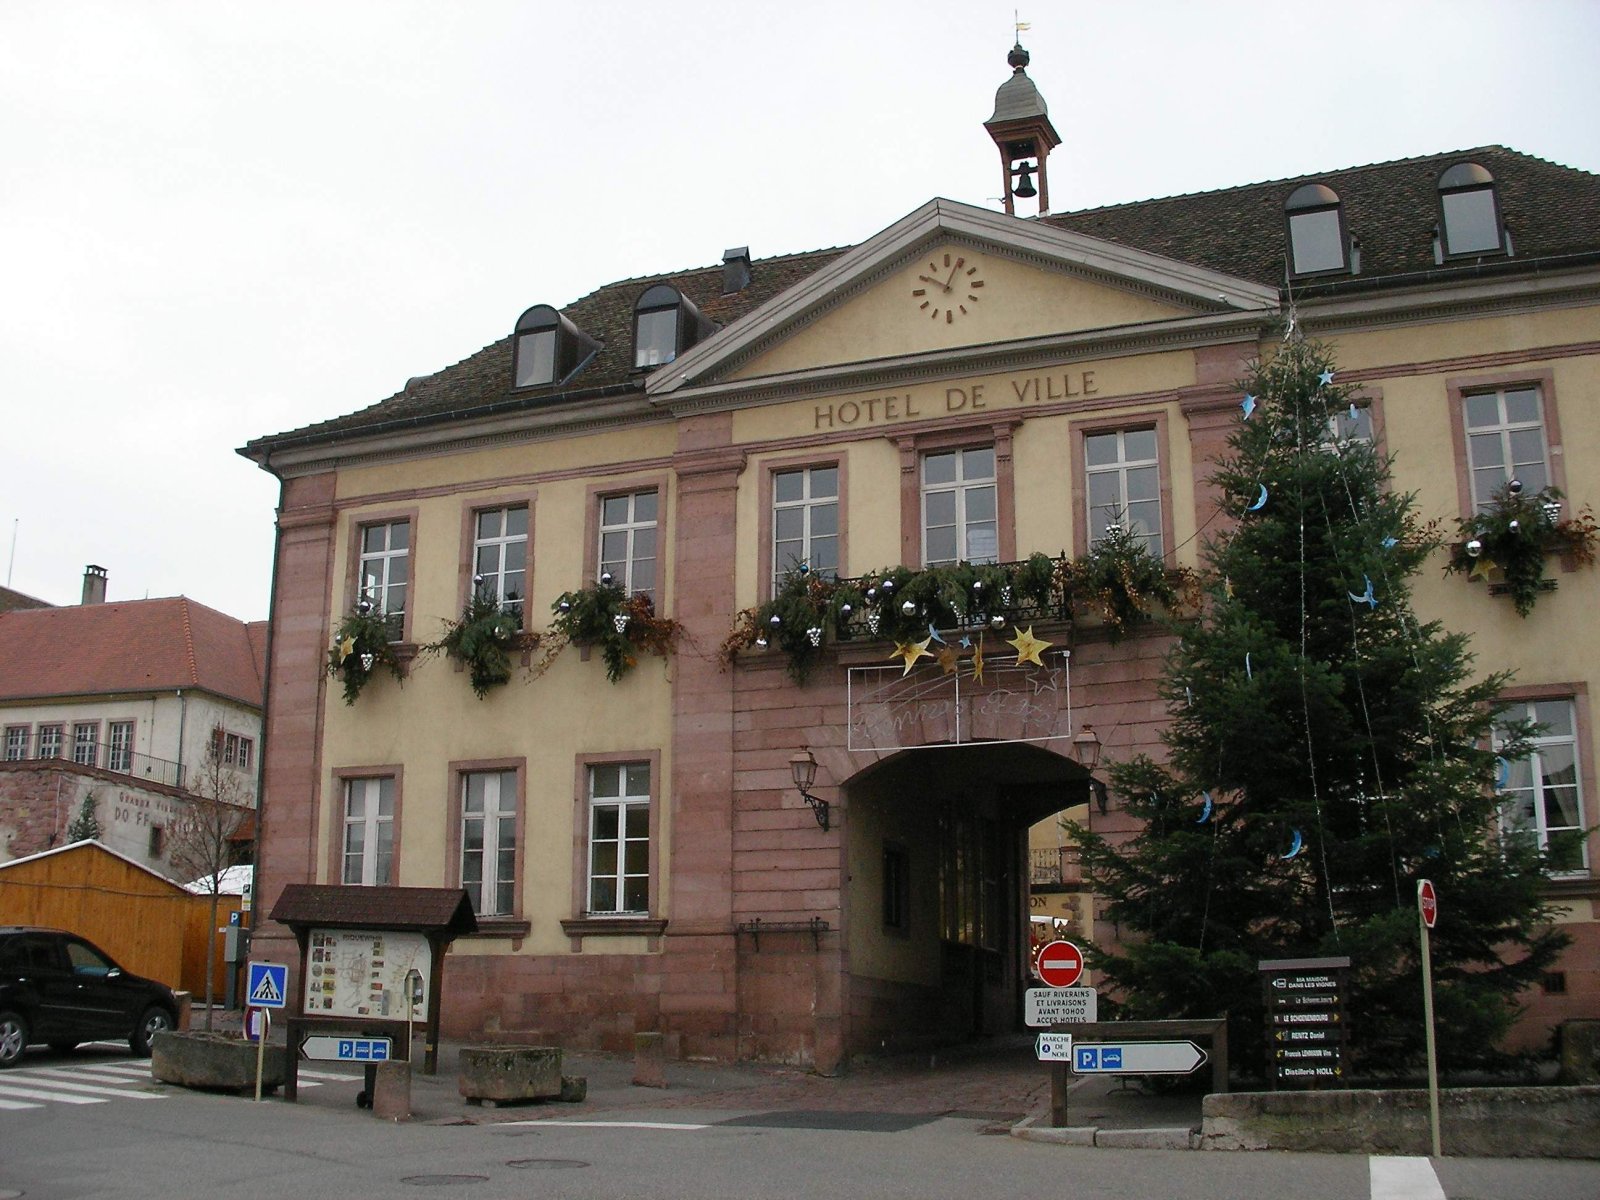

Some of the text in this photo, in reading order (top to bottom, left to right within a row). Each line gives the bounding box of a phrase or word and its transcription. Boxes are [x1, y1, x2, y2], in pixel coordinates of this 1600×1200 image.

[814, 371, 1099, 429] HOTEL DE VILLE
[1422, 896, 1434, 910] STOP
[231, 912, 238, 923] P
[1053, 990, 1090, 998] RIVERAINS
[1046, 999, 1087, 1007] LIVRAISONS
[342, 1043, 350, 1055] P
[1082, 1052, 1093, 1066] P
[1285, 1068, 1315, 1076] Distillerie
